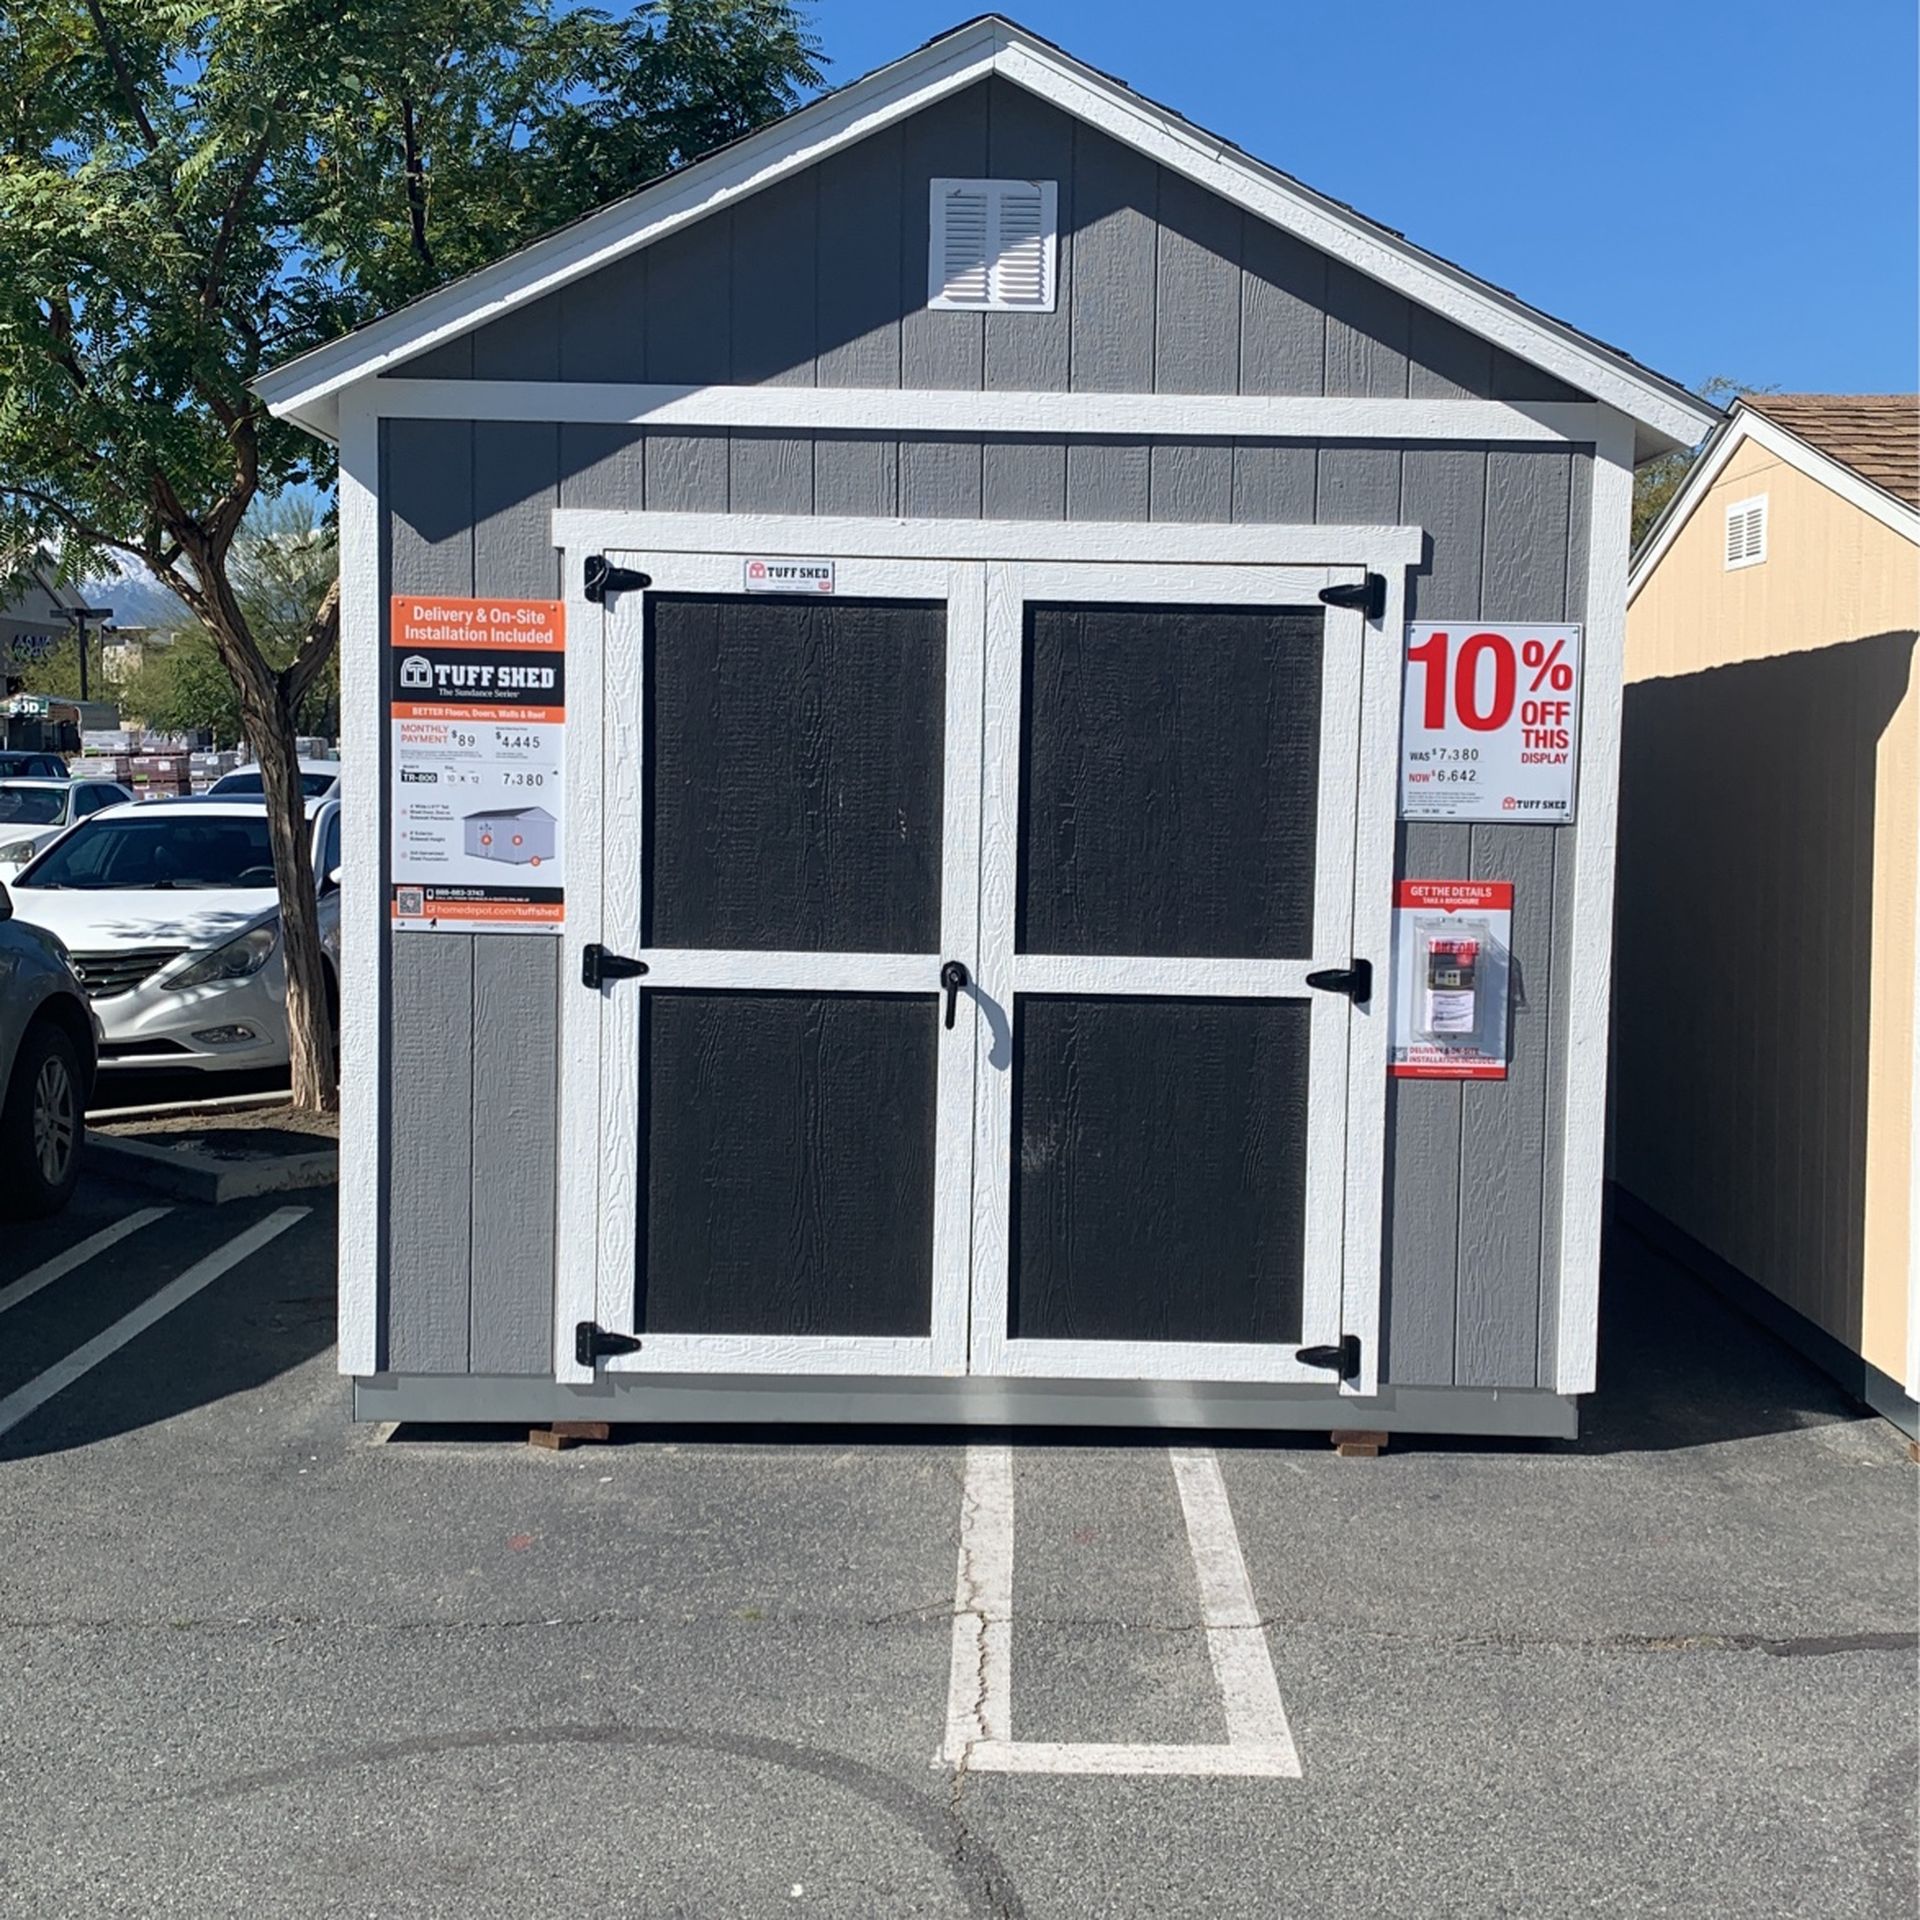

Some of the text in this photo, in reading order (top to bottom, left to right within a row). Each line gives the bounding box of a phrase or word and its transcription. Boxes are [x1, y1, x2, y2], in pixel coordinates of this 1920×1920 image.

[767, 567, 829, 579] TUFF SHED
[413, 606, 545, 625] Delivery & On-Site
[405, 625, 553, 644] Installation Included
[434, 664, 555, 689] TUFF SHED
[1407, 632, 1573, 732] 10%
[439, 688, 453, 696] The
[455, 688, 493, 697] Sundance
[412, 707, 444, 717] BETTER
[1521, 701, 1571, 726] OFF
[401, 724, 449, 733] MONTHLY
[401, 734, 448, 744] PAYMENT
[1521, 729, 1569, 749] THIS
[1410, 752, 1430, 761] WAS
[1521, 753, 1568, 764] DISPLAY
[1409, 773, 1430, 783] NOW
[1516, 800, 1567, 810] TUFF SHED
[1411, 886, 1492, 898] GET THE DETAILS
[437, 904, 560, 917] homedepot.com/tuffshed
